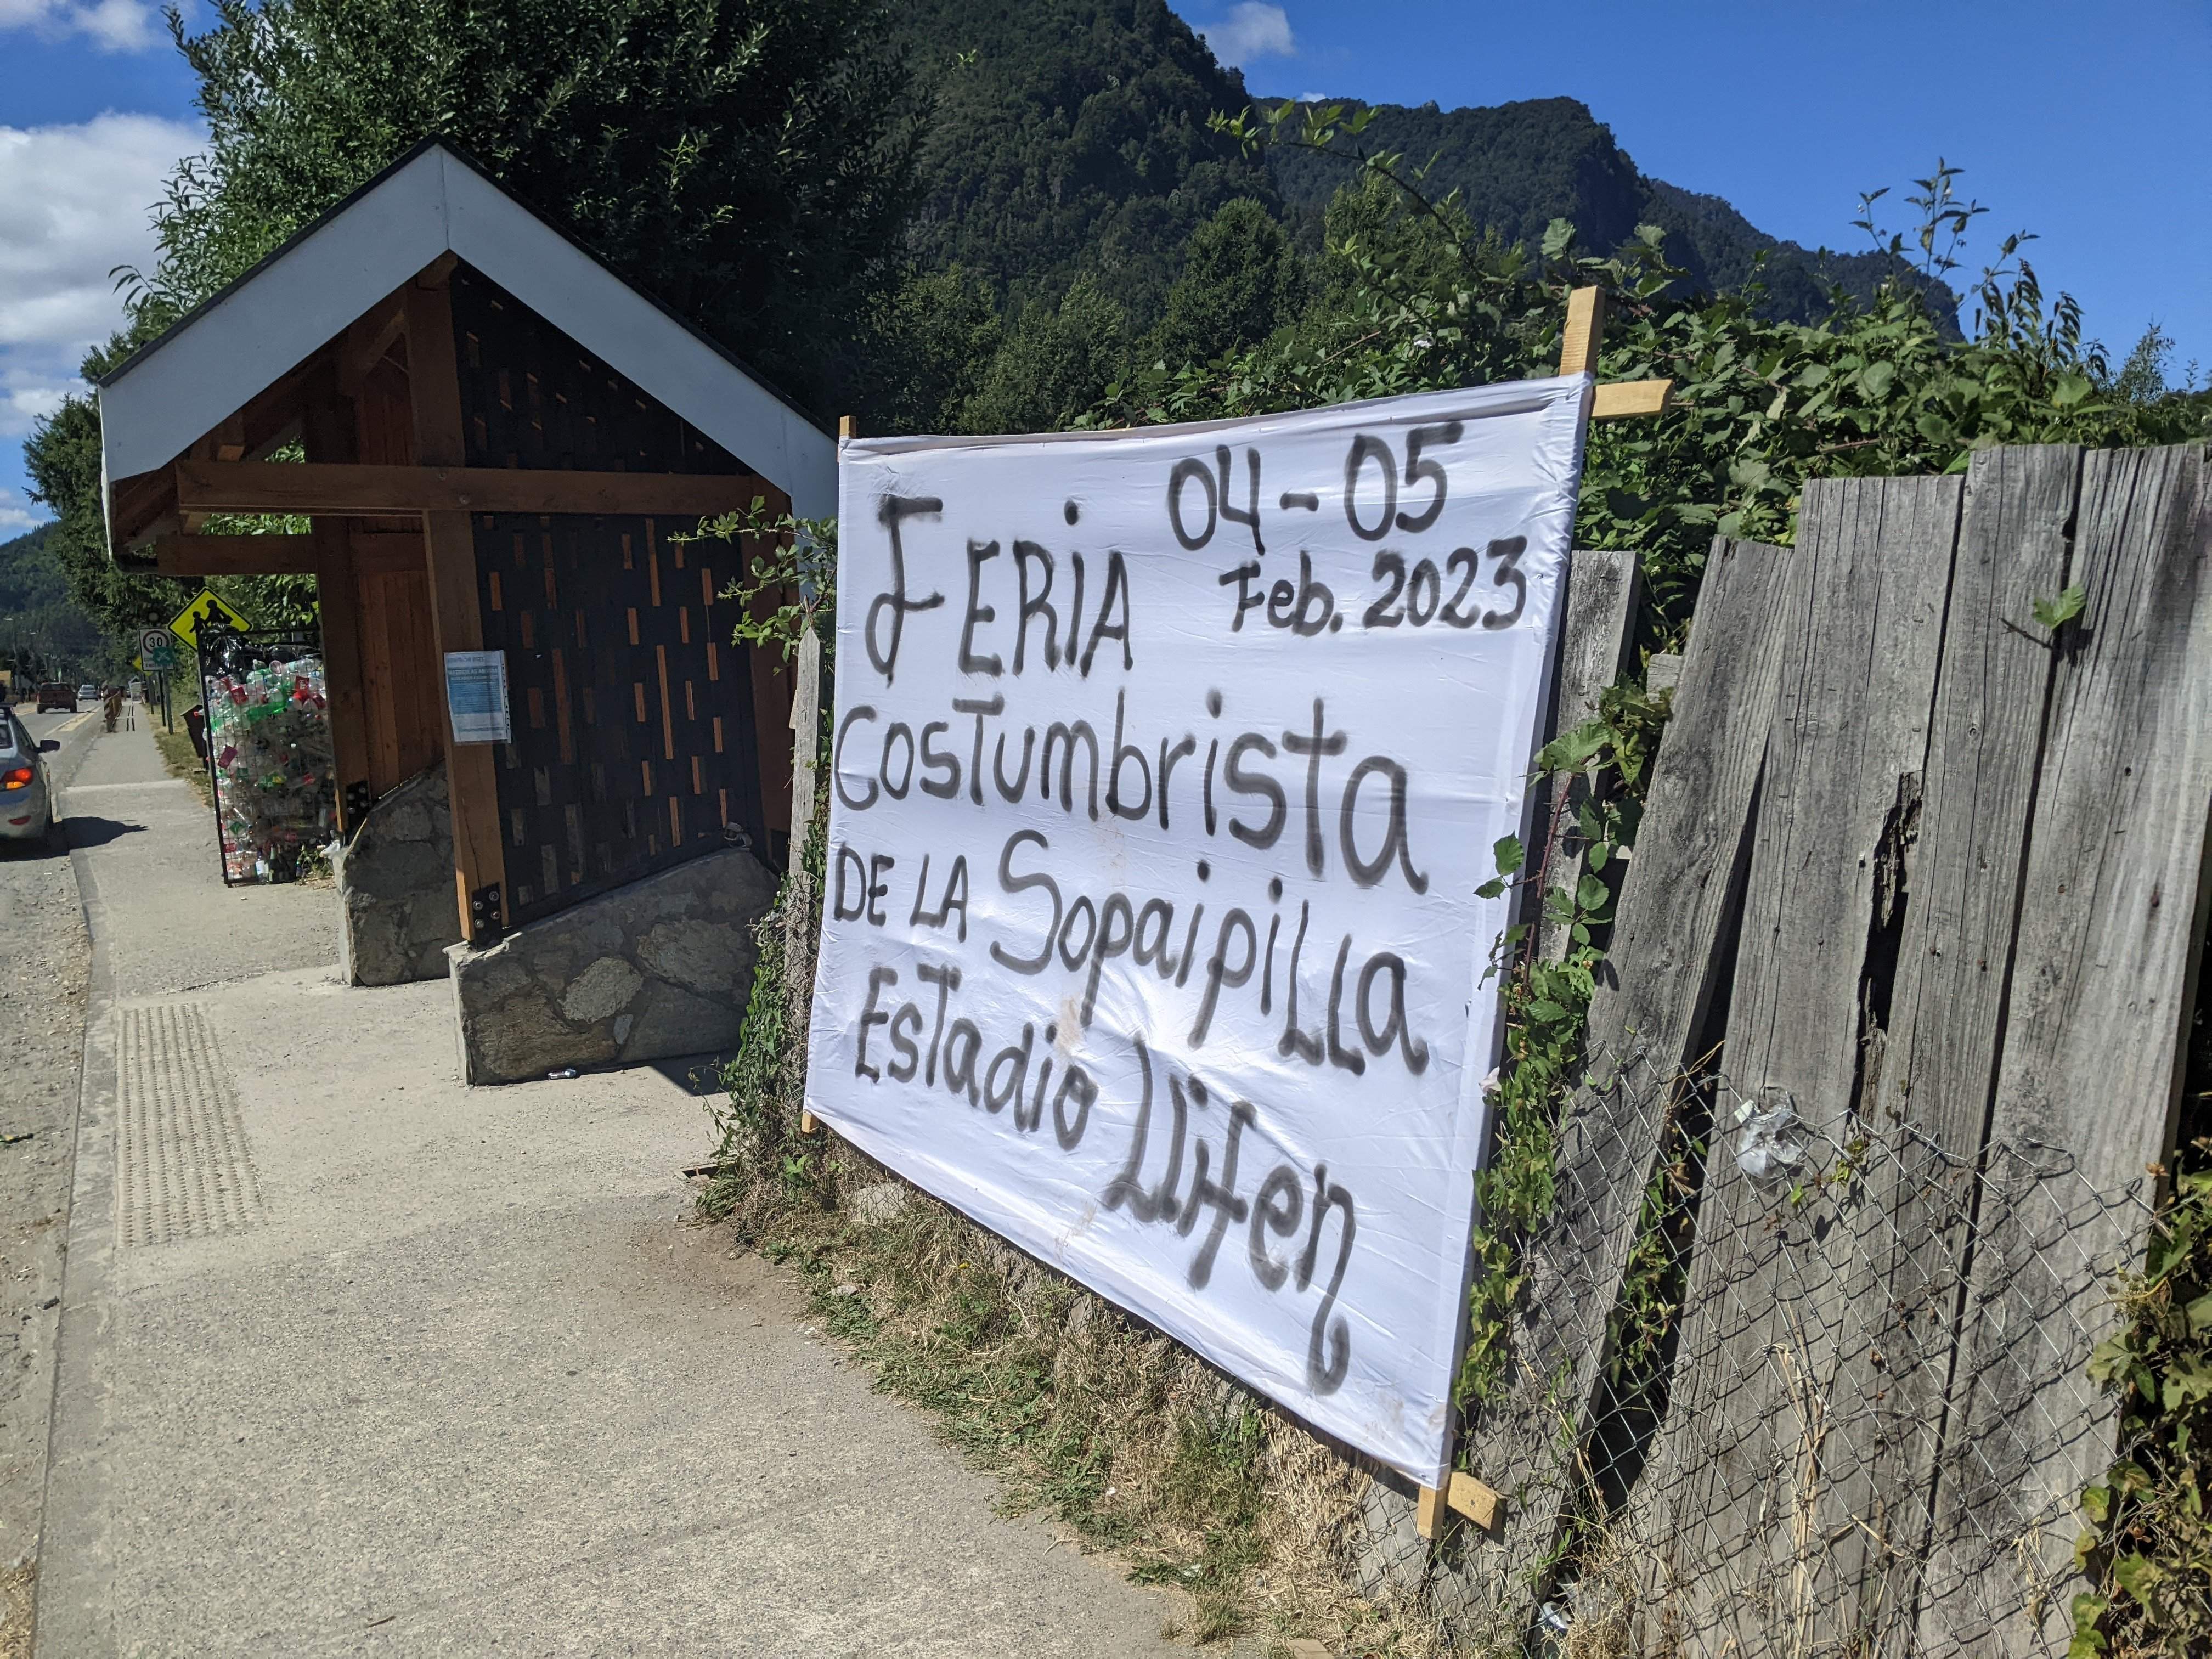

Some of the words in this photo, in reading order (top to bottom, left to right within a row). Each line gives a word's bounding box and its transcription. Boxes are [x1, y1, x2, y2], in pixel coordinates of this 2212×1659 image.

[1219, 550, 1342, 637] Feb.
[1362, 535, 1528, 630] 2023
[149, 637, 163, 647] 30
[832, 842, 896, 927] DE
[909, 852, 970, 944] LA
